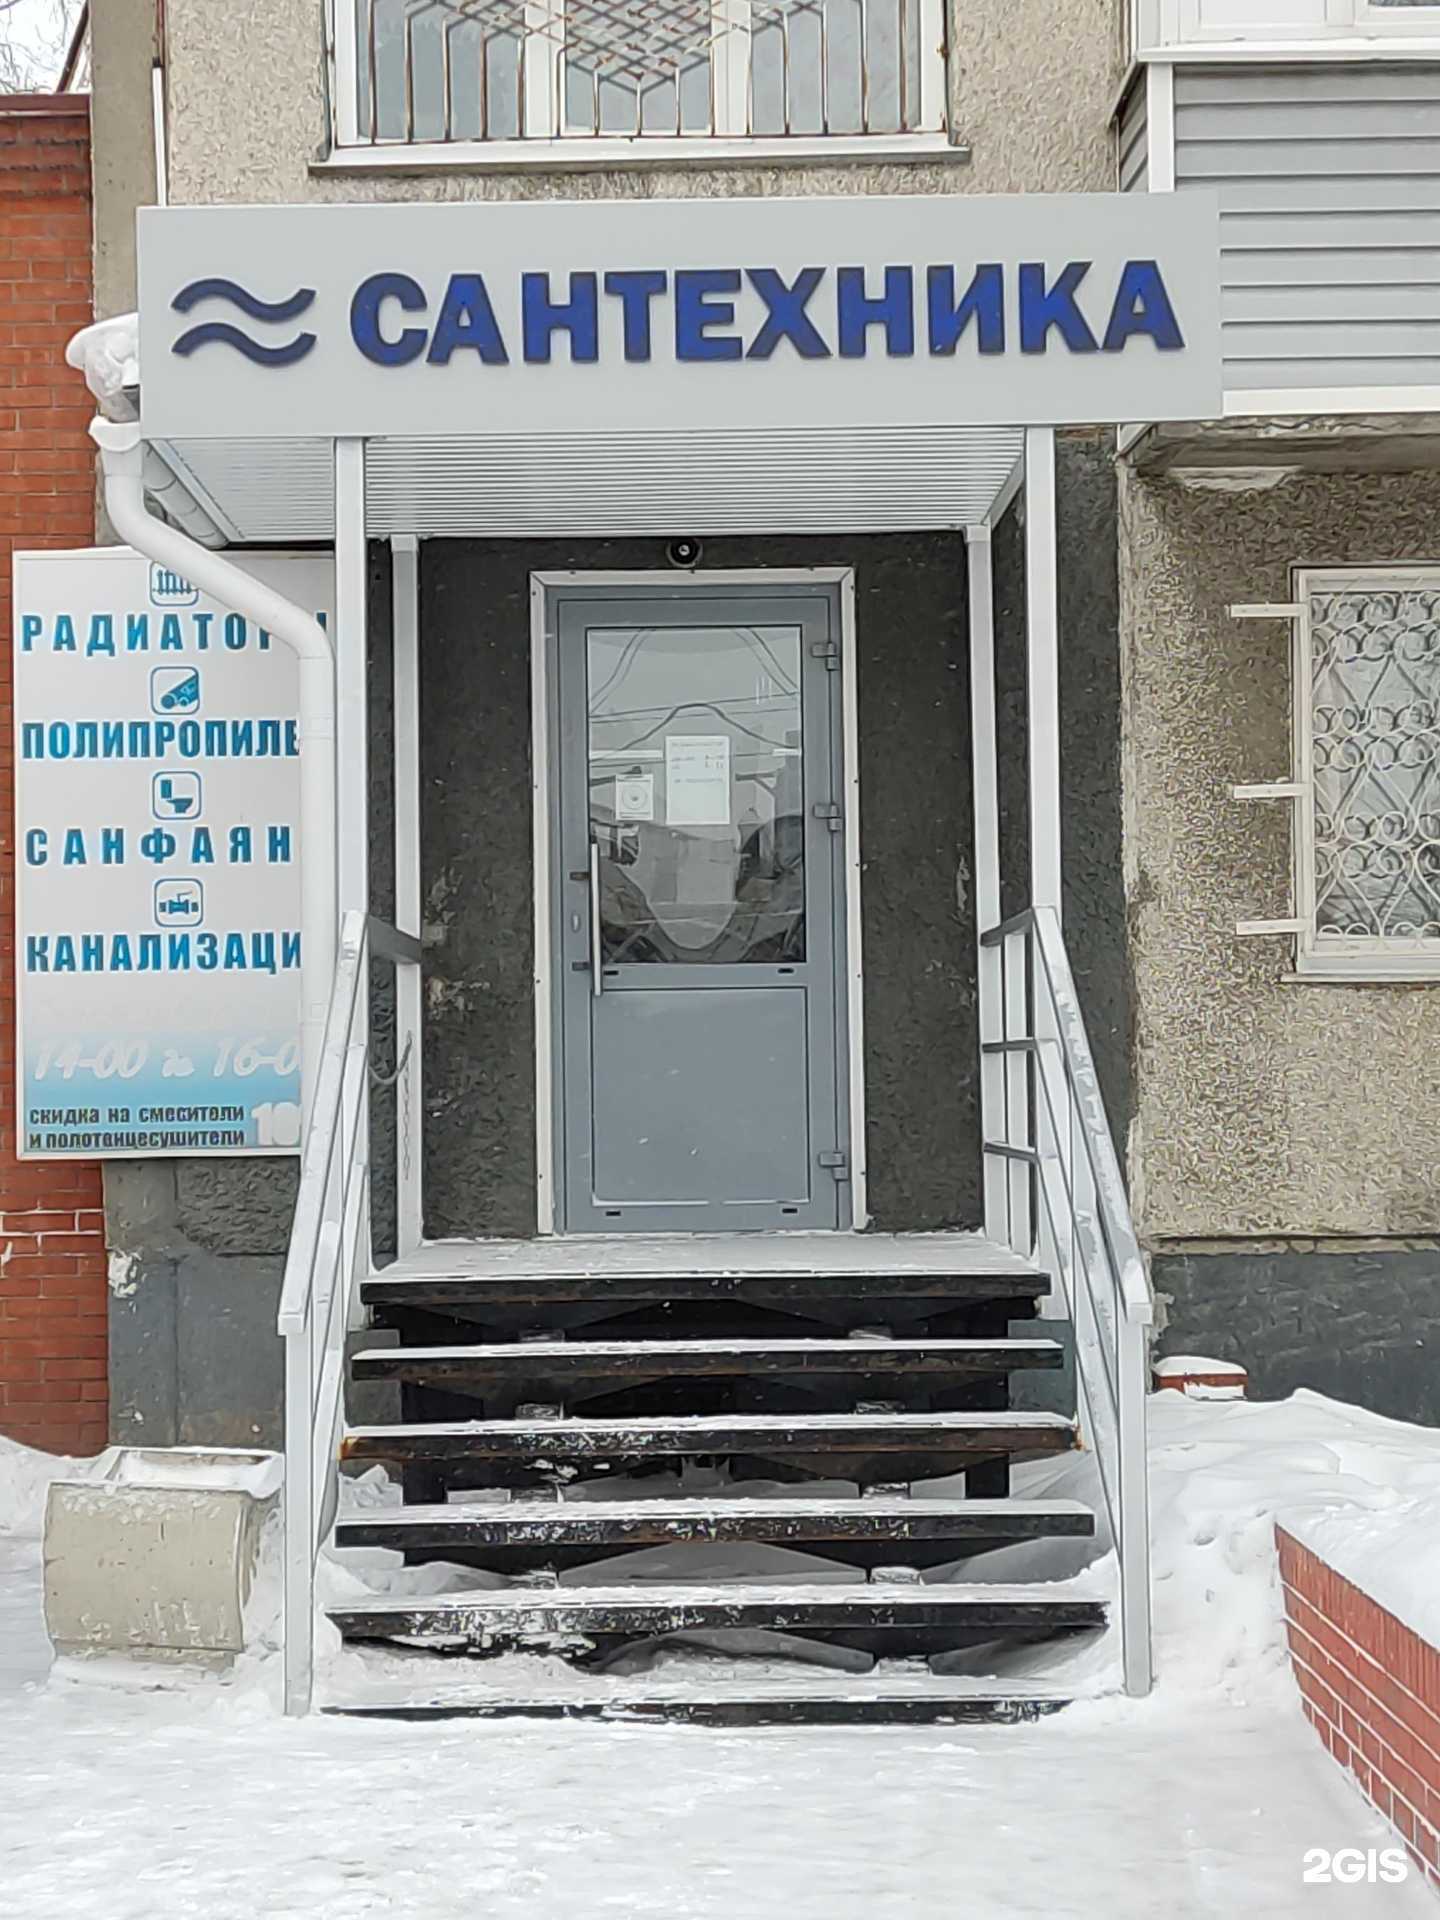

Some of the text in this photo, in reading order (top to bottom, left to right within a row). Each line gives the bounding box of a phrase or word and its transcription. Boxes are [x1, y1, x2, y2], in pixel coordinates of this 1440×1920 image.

[350, 259, 1186, 367] САНТЕХНИКА
[21, 612, 327, 657] РАДИАТО
[26, 931, 301, 974] КАНАЛИЗАЦИ
[29, 1105, 244, 1126] скидка на смесители
